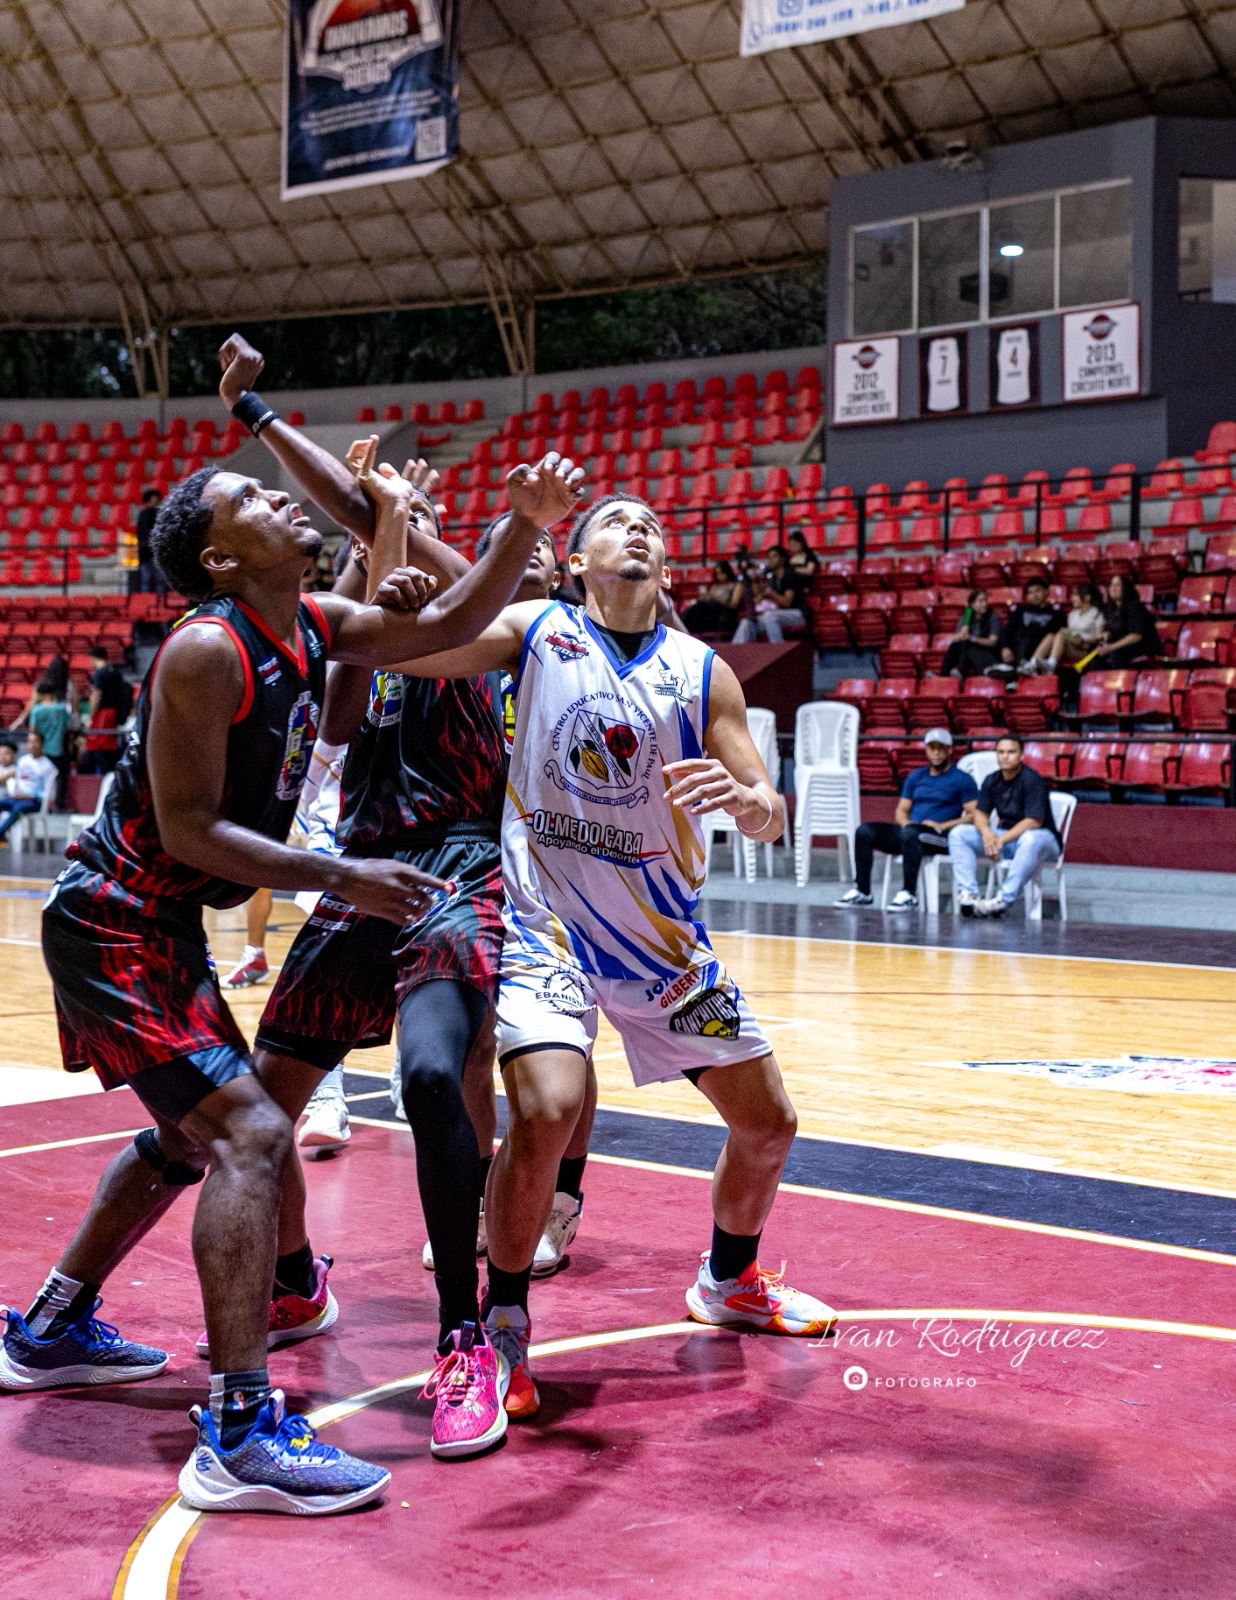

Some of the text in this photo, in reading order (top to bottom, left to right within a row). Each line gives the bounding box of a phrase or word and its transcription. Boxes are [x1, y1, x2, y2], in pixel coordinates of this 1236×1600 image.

[941, 354, 948, 376] 7
[1009, 346, 1018, 368] 4
[1087, 343, 1116, 365] 2013
[853, 372, 879, 391] 2012
[1108, 376, 1131, 389] NORTE
[566, 690, 615, 715] EDUCATIVO
[552, 713, 569, 751] CENTRO
[633, 706, 657, 742] VICENTE
[650, 743, 658, 757] DE
[641, 758, 656, 780] PAUL
[533, 809, 602, 847] OLMEDO
[537, 834, 588, 854] Apoyando
[590, 846, 600, 857] el
[660, 970, 700, 1008] GILBERT
